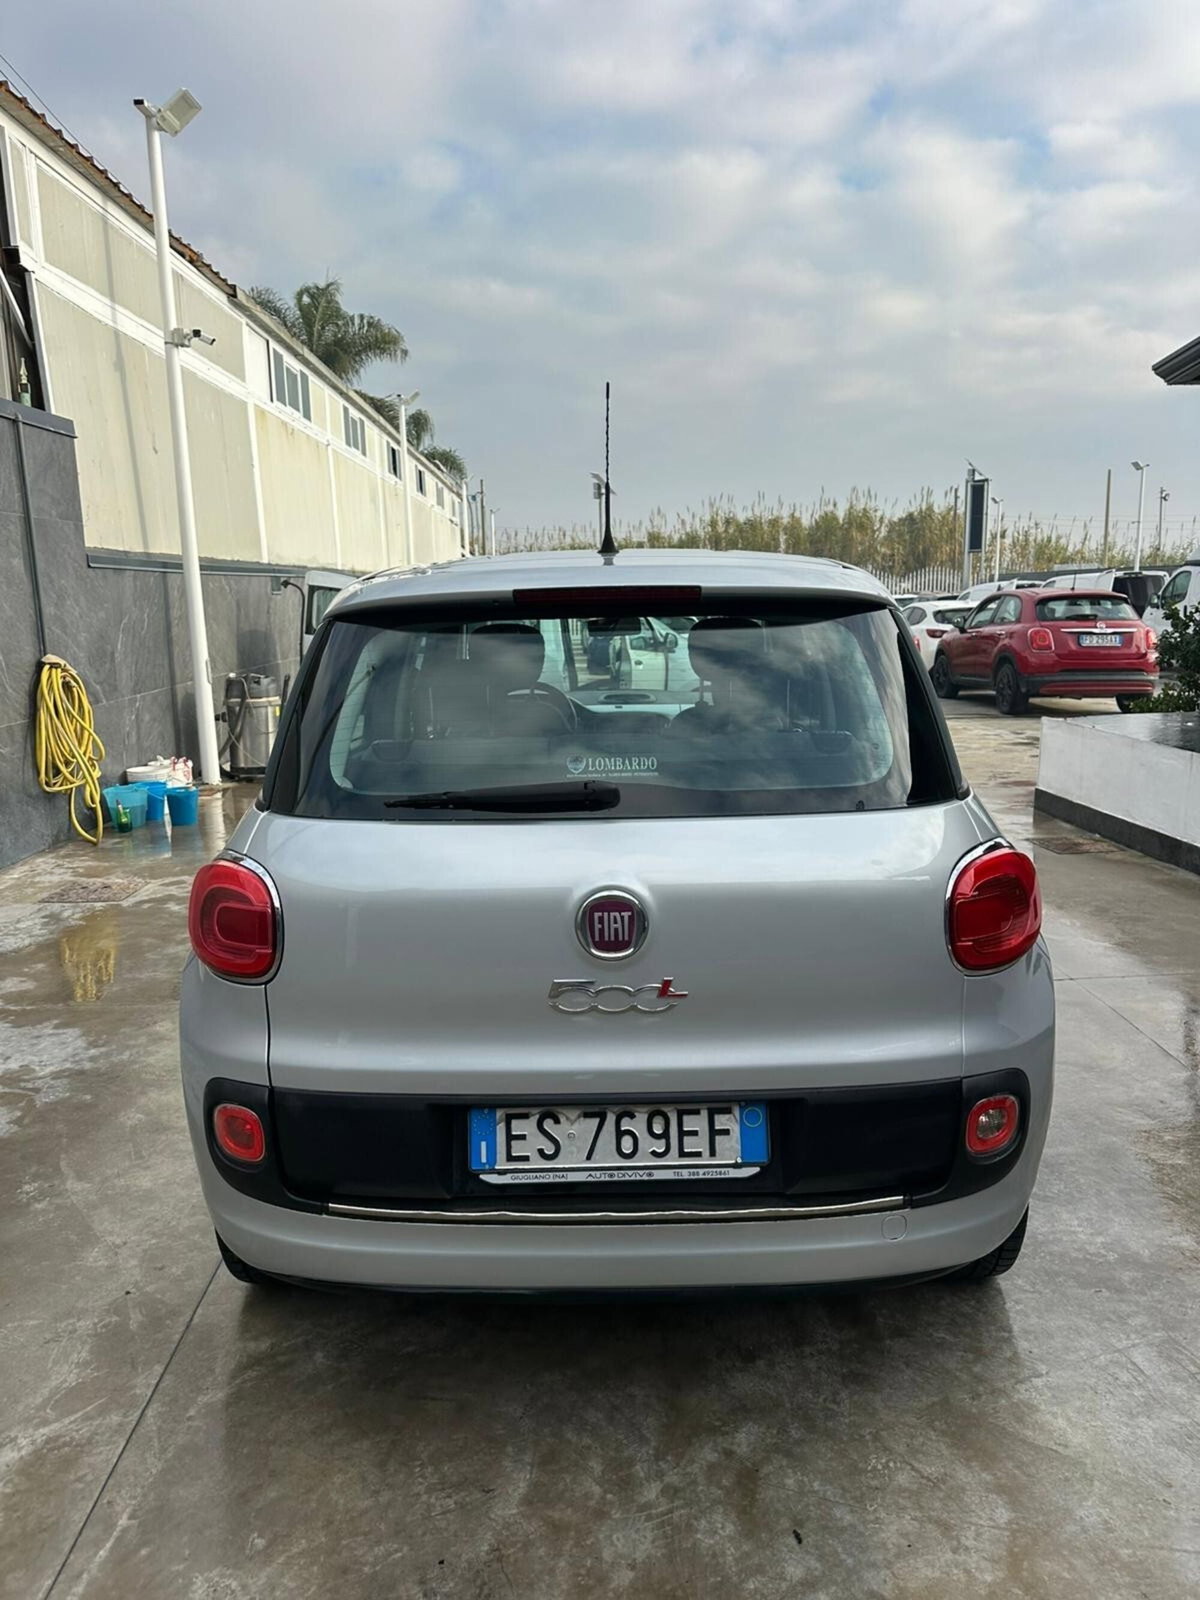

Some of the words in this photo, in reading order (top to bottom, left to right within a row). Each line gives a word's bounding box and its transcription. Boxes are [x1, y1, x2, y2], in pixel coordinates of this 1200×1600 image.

[588, 757, 658, 771] LOMBARDO
[593, 912, 632, 941] FIAT
[548, 977, 688, 1012] 500L
[505, 1111, 562, 1162] ES
[582, 1107, 732, 1160] 769EF
